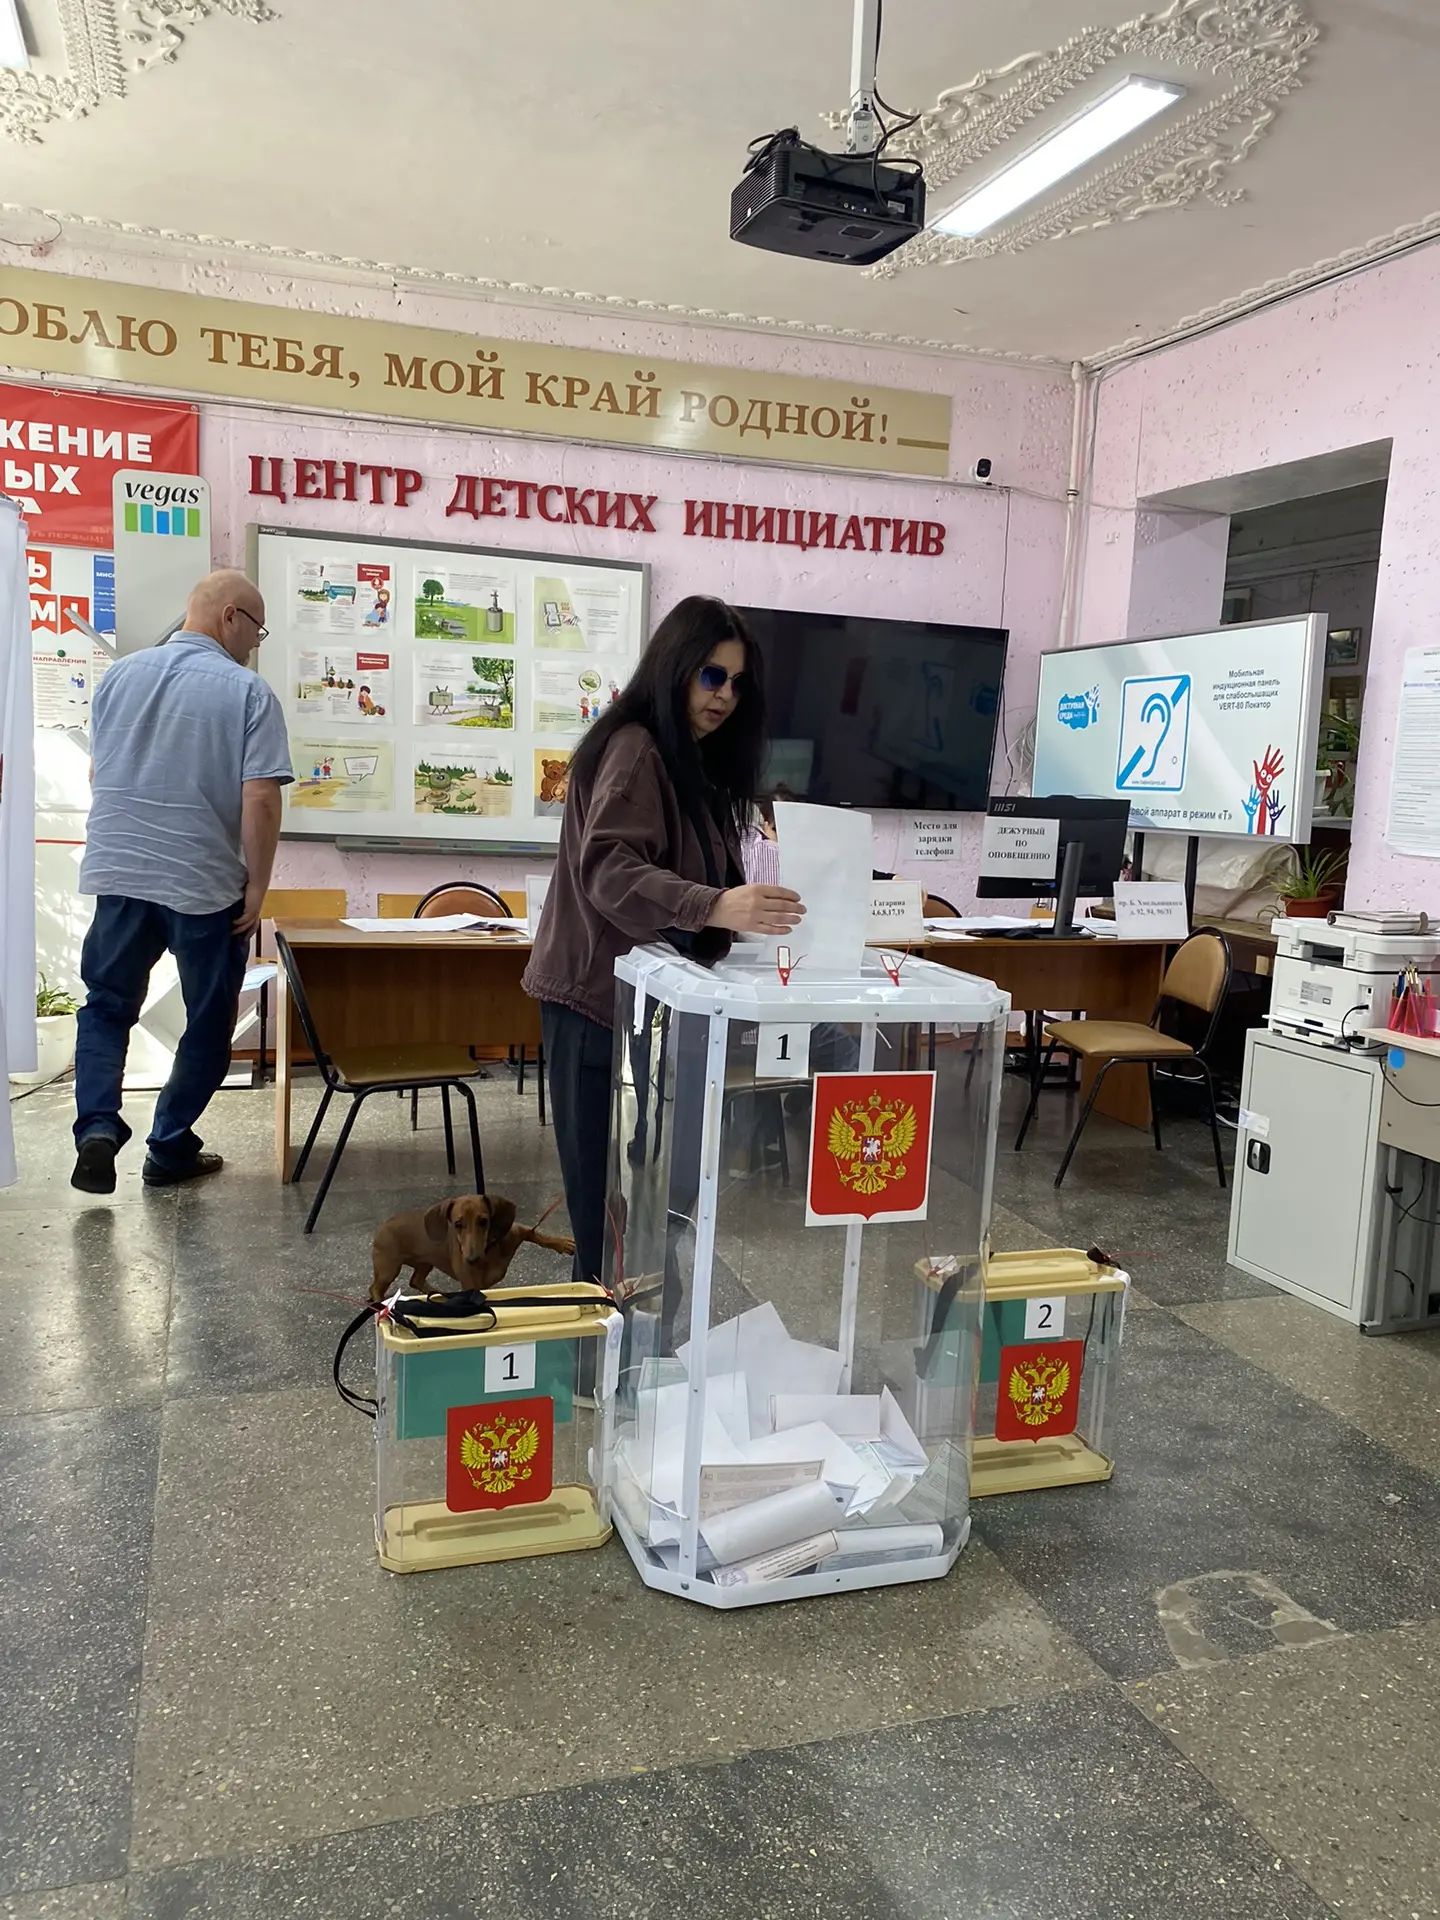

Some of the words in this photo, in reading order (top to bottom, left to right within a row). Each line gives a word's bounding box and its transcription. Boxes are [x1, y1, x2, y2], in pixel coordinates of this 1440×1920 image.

[201, 327, 360, 388] ТЕБЯ,
[384, 349, 505, 400] МОЙ
[525, 370, 662, 418] КРАЙ
[680, 391, 888, 444] РОДНОЙ!
[5, 459, 82, 496] ЫХ
[125, 483, 200, 507] vegas
[248, 455, 423, 507] ЦЕНТР
[445, 474, 659, 533] ДЕТСКИХ
[683, 499, 947, 557] ИНИЦИАТИВ
[96, 570, 115, 578] МИС
[1228, 669, 1265, 678] Мобильная
[1257, 679, 1281, 687] панель
[1213, 693, 1225, 701] для
[1151, 808, 1181, 819] аппарат
[1189, 811, 1216, 821] режим
[914, 821, 941, 830] Место
[942, 823, 958, 831] для
[997, 826, 1045, 835] ДЕЖУРНЫЙ
[918, 835, 952, 845] зарядки
[1015, 839, 1028, 847] ПО
[915, 847, 954, 857] телефона
[988, 851, 1051, 860] ОПОВЕЩЕНИЮ
[776, 1033, 791, 1060] 1
[1038, 1304, 1052, 1328] 2
[502, 1352, 519, 1380] 1
